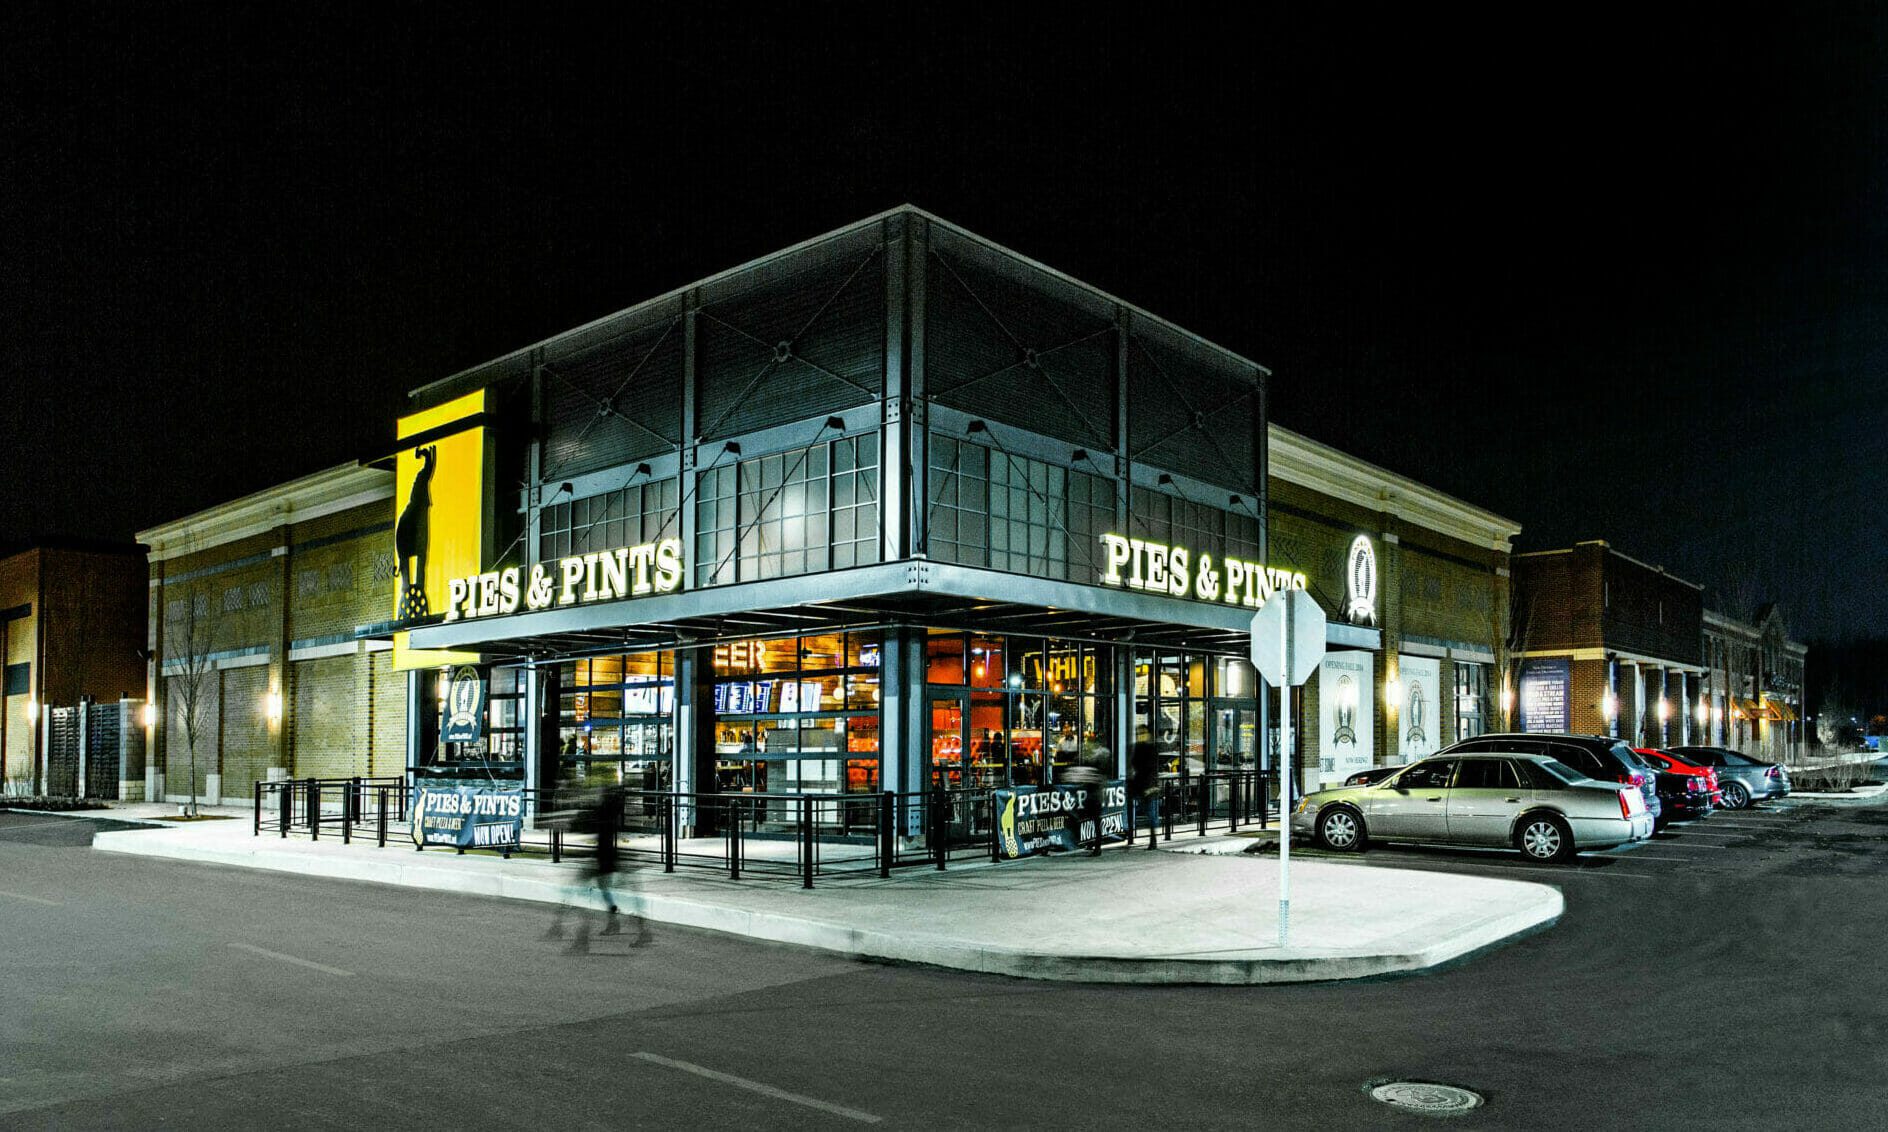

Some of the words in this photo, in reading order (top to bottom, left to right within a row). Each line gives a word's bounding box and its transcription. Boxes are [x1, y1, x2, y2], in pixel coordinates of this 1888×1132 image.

[444, 566, 520, 621] PIES
[527, 563, 553, 610] &
[560, 538, 684, 604] PINTS
[1099, 533, 1190, 596] PIES
[1195, 553, 1220, 601] &
[425, 793, 459, 813] PIES
[460, 795, 472, 814] &
[473, 795, 520, 816] PINTS
[1017, 791, 1061, 817] PIES
[1062, 790, 1077, 811] &
[1077, 786, 1126, 809] PTS
[473, 825, 490, 846] NOW
[490, 824, 516, 844] OPEN!
[1101, 814, 1124, 836] OPEN!
